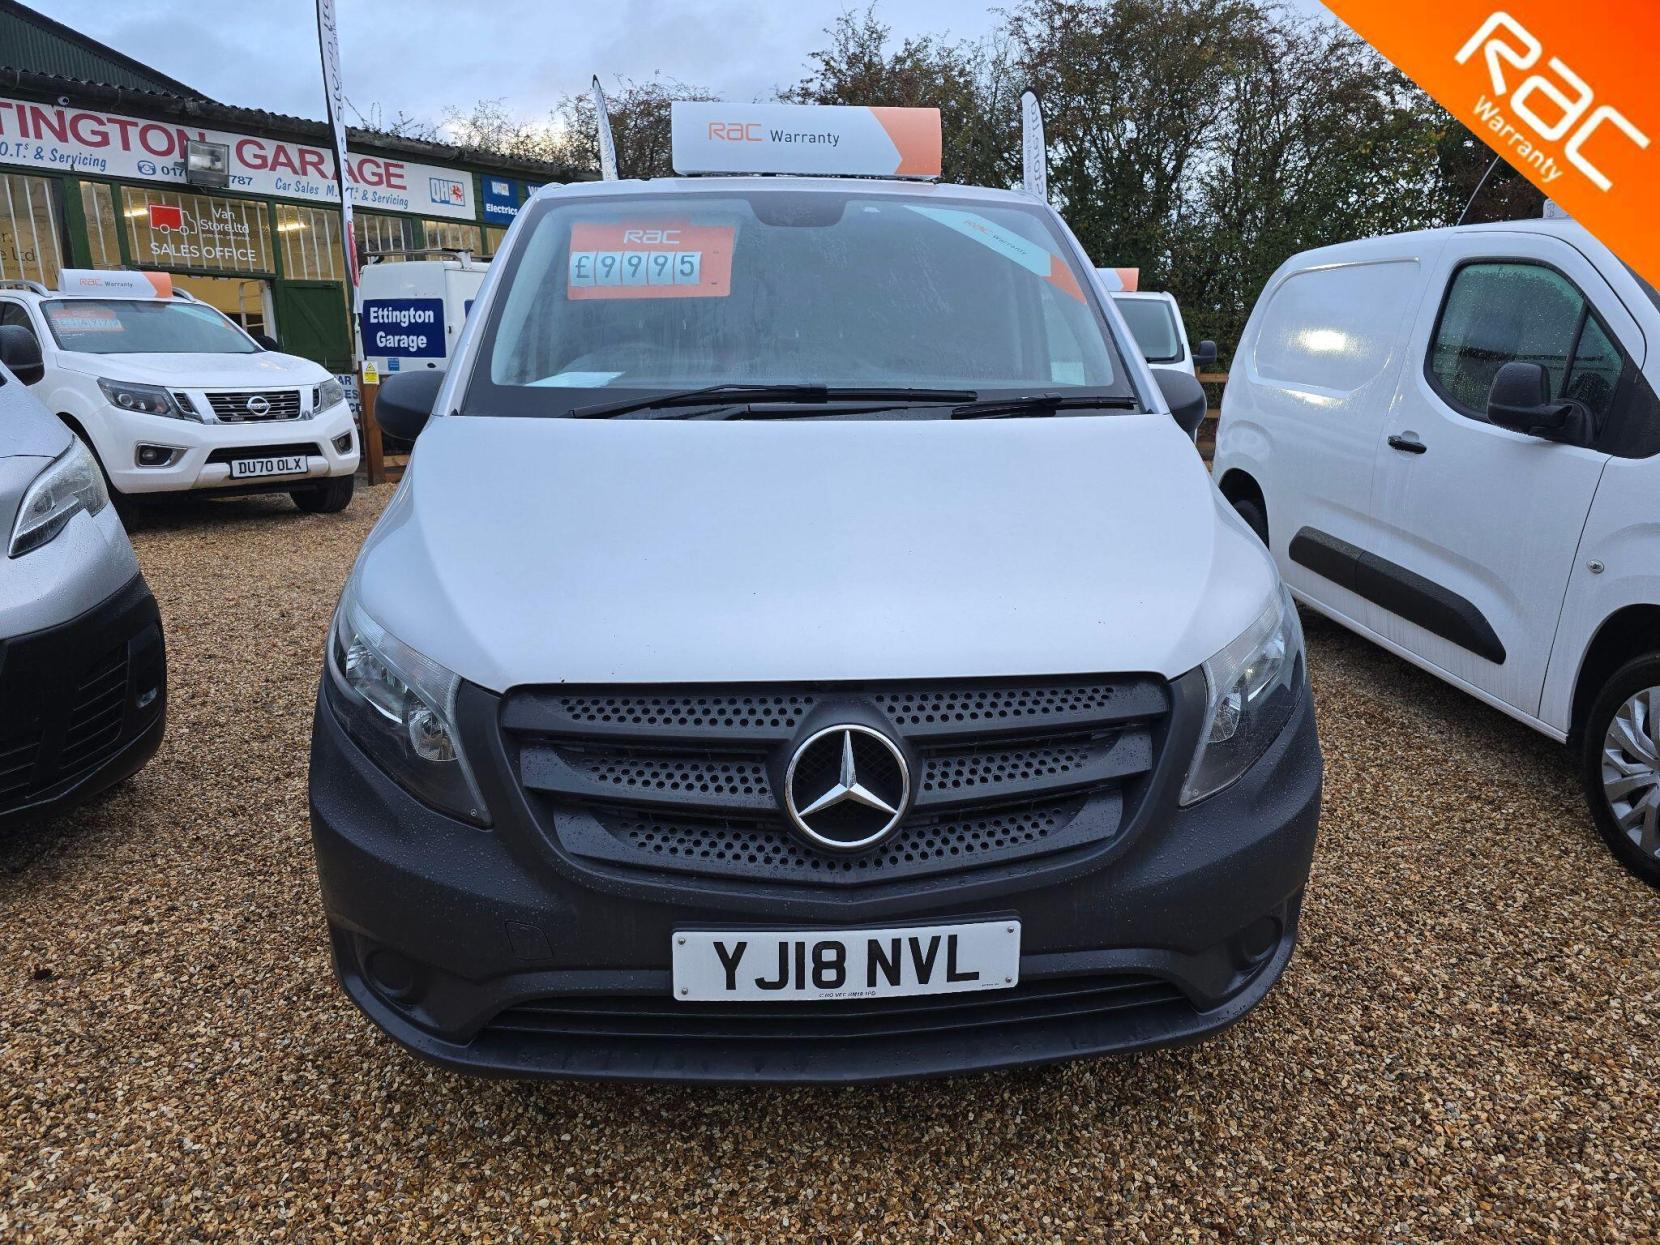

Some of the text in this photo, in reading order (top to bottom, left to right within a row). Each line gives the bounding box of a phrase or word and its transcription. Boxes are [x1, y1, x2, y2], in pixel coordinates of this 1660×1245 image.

[769, 129, 840, 147] Warranty
[34, 145, 44, 160] &
[49, 148, 107, 172] Servicing
[275, 177, 291, 190] Car
[294, 180, 319, 195] Sales
[361, 190, 369, 201] &
[371, 191, 409, 209] Servicing
[212, 207, 235, 219] Van
[485, 203, 518, 215] Electrics
[151, 242, 256, 261] SALES OFFICE
[575, 254, 696, 279] £9995
[369, 307, 435, 327] Ettington
[376, 331, 428, 351] Garage
[338, 375, 352, 385] AR
[238, 458, 302, 474] DU70 OLX
[713, 934, 980, 990] YJ18 NVL
